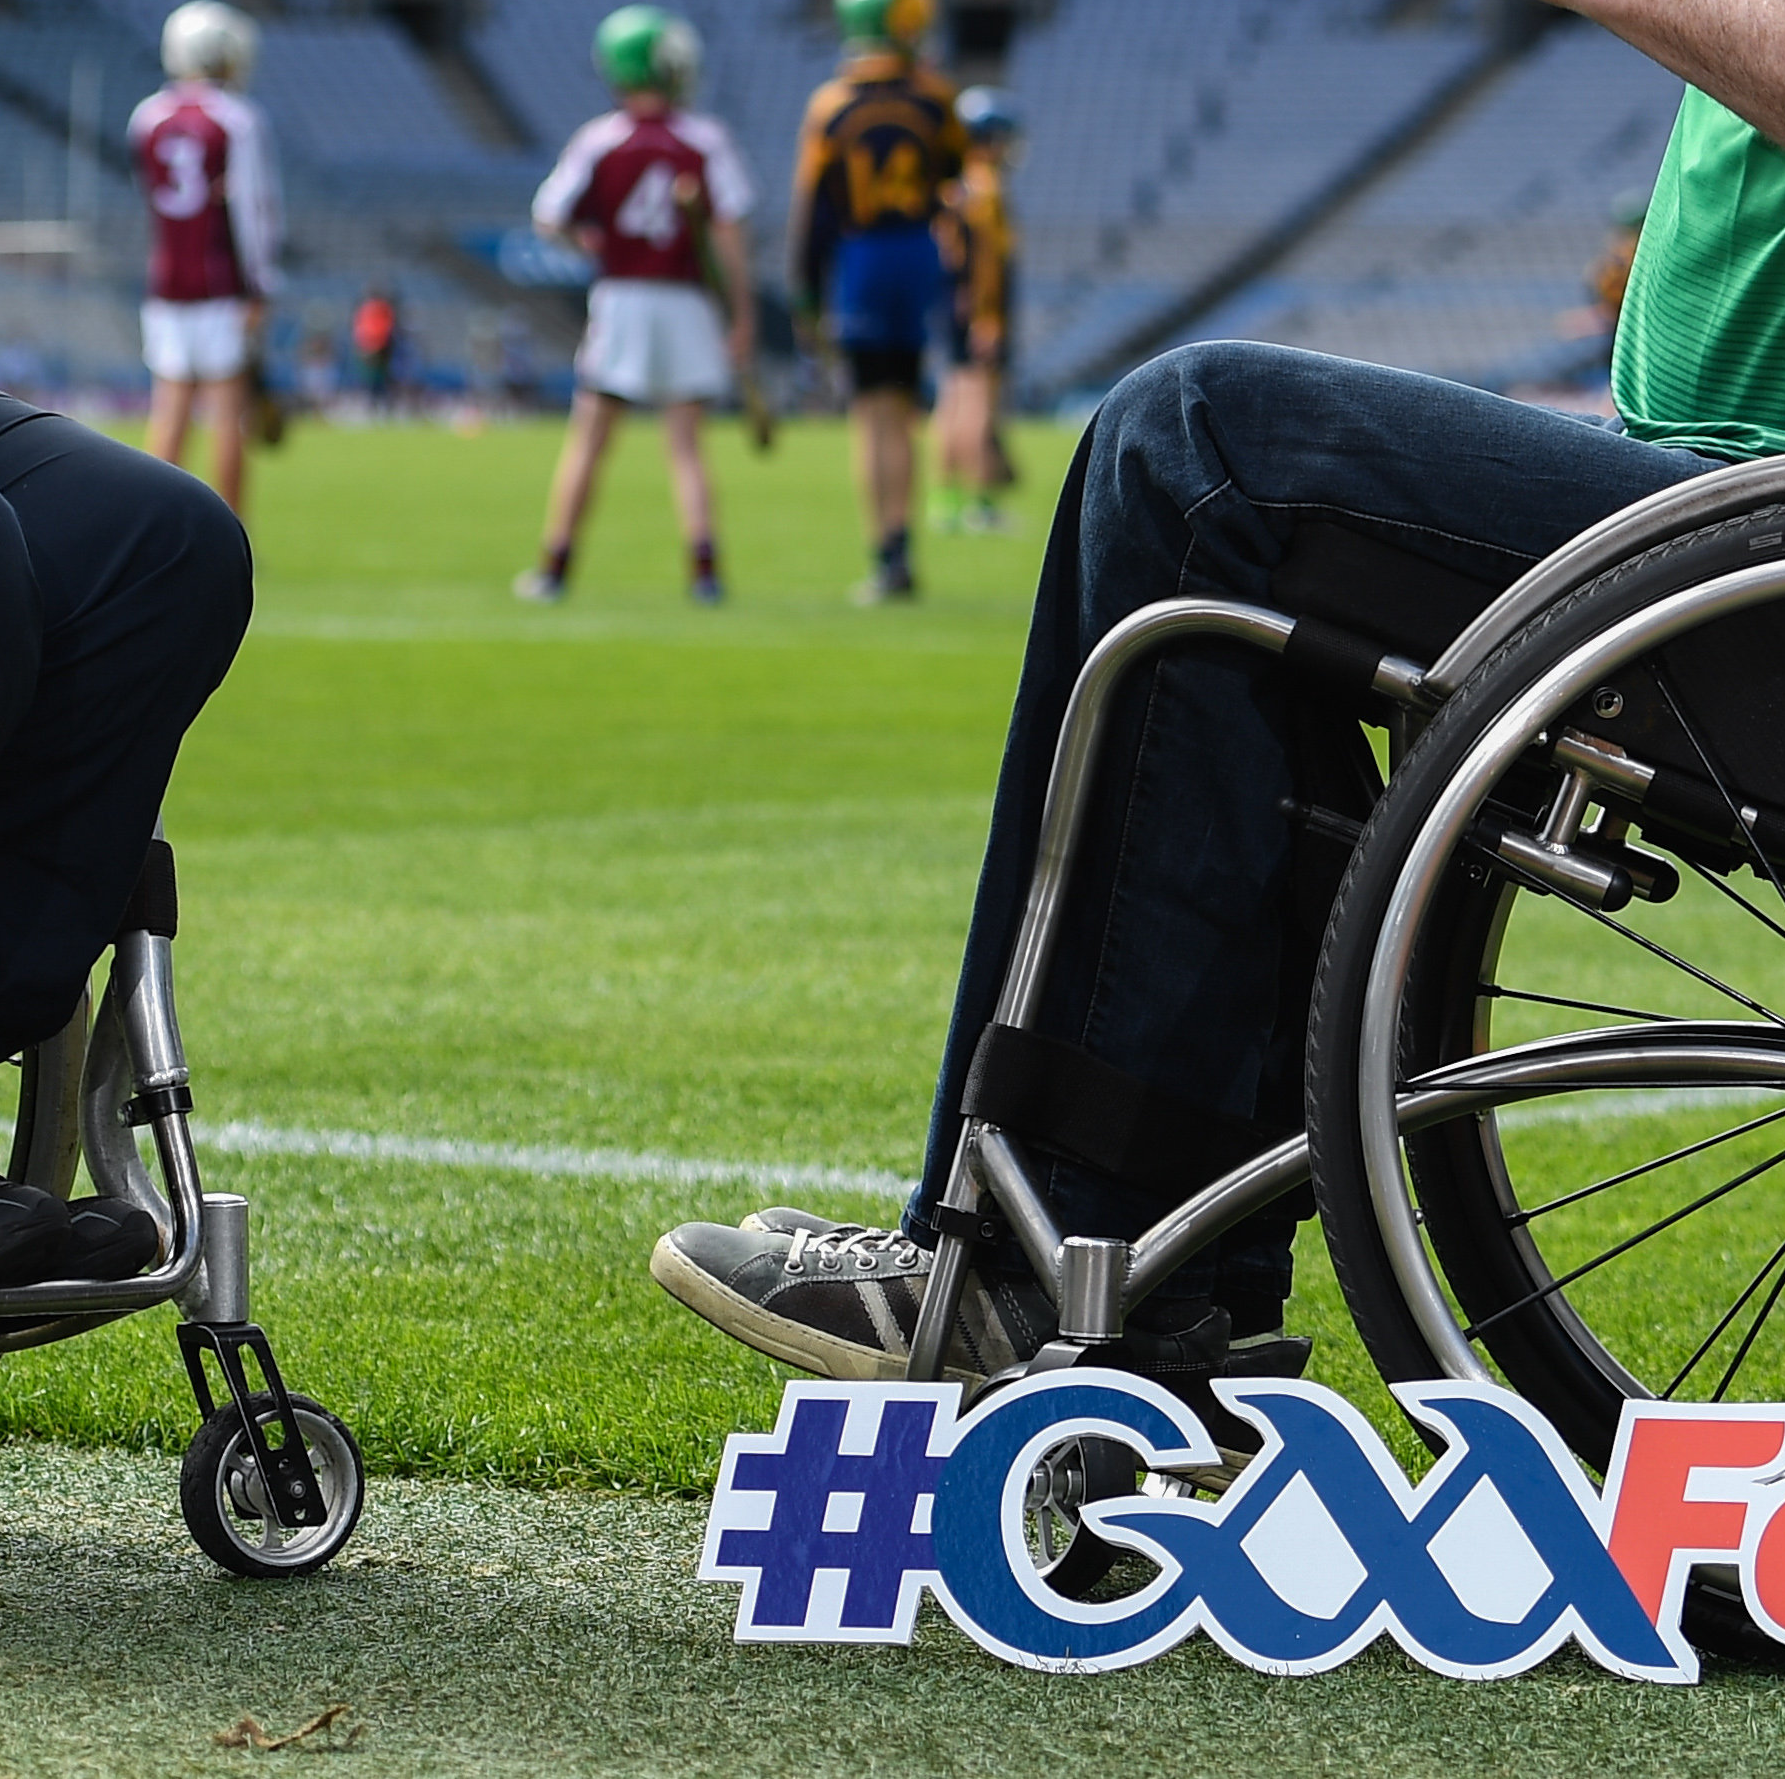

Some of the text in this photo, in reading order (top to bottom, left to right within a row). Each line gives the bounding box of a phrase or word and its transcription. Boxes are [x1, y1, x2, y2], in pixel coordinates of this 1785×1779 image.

[153, 131, 212, 221] 3
[615, 158, 678, 249] 4
[845, 137, 926, 227] 14
